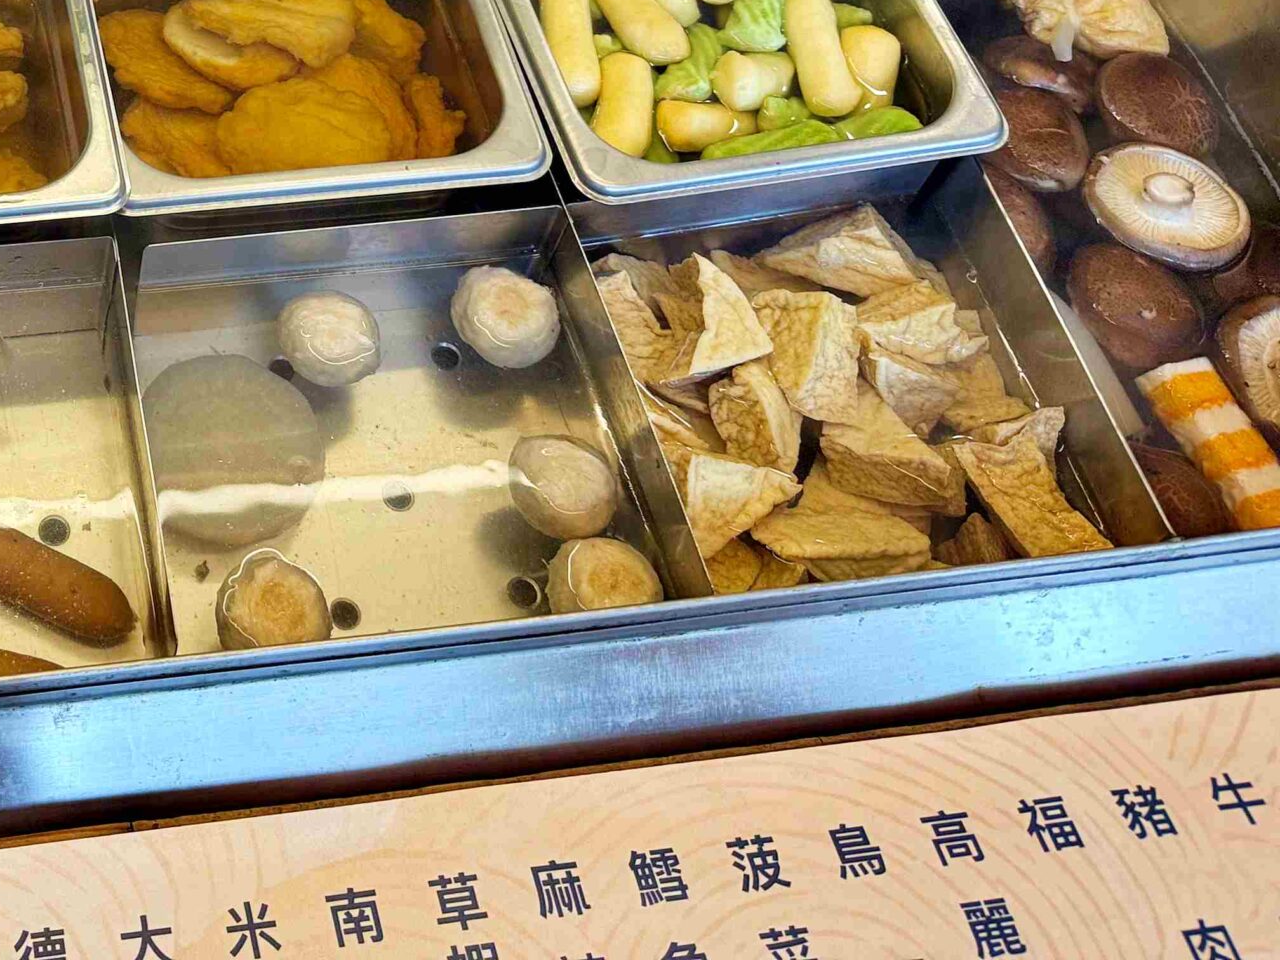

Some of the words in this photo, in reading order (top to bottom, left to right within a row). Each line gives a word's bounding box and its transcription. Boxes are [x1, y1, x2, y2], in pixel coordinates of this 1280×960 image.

[1019, 797, 1085, 853] 福
[1212, 774, 1267, 825] 牛
[829, 824, 887, 880] 鳥
[921, 812, 1027, 960] 高麗
[121, 915, 173, 960] 大
[227, 902, 283, 959] 米
[326, 888, 384, 948] 南
